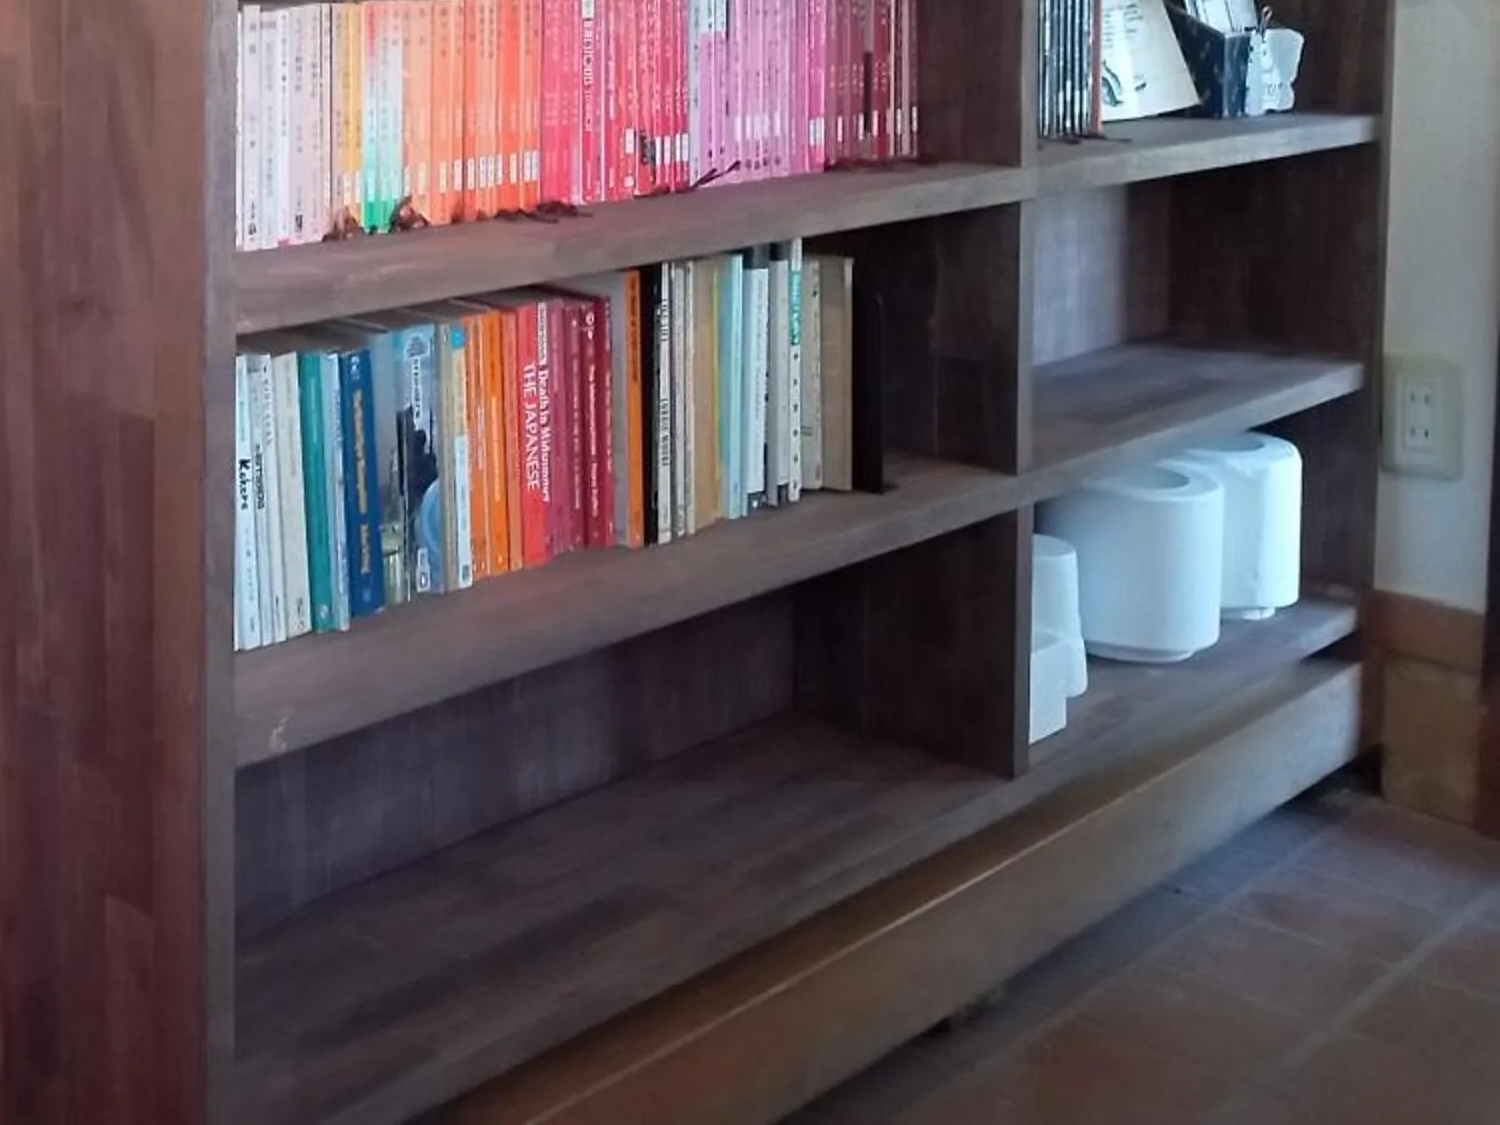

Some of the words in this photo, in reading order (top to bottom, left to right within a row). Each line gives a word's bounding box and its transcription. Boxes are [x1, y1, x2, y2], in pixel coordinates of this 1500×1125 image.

[522, 362, 538, 398] THE
[538, 366, 550, 408] Death
[524, 401, 541, 491] JAPANESE
